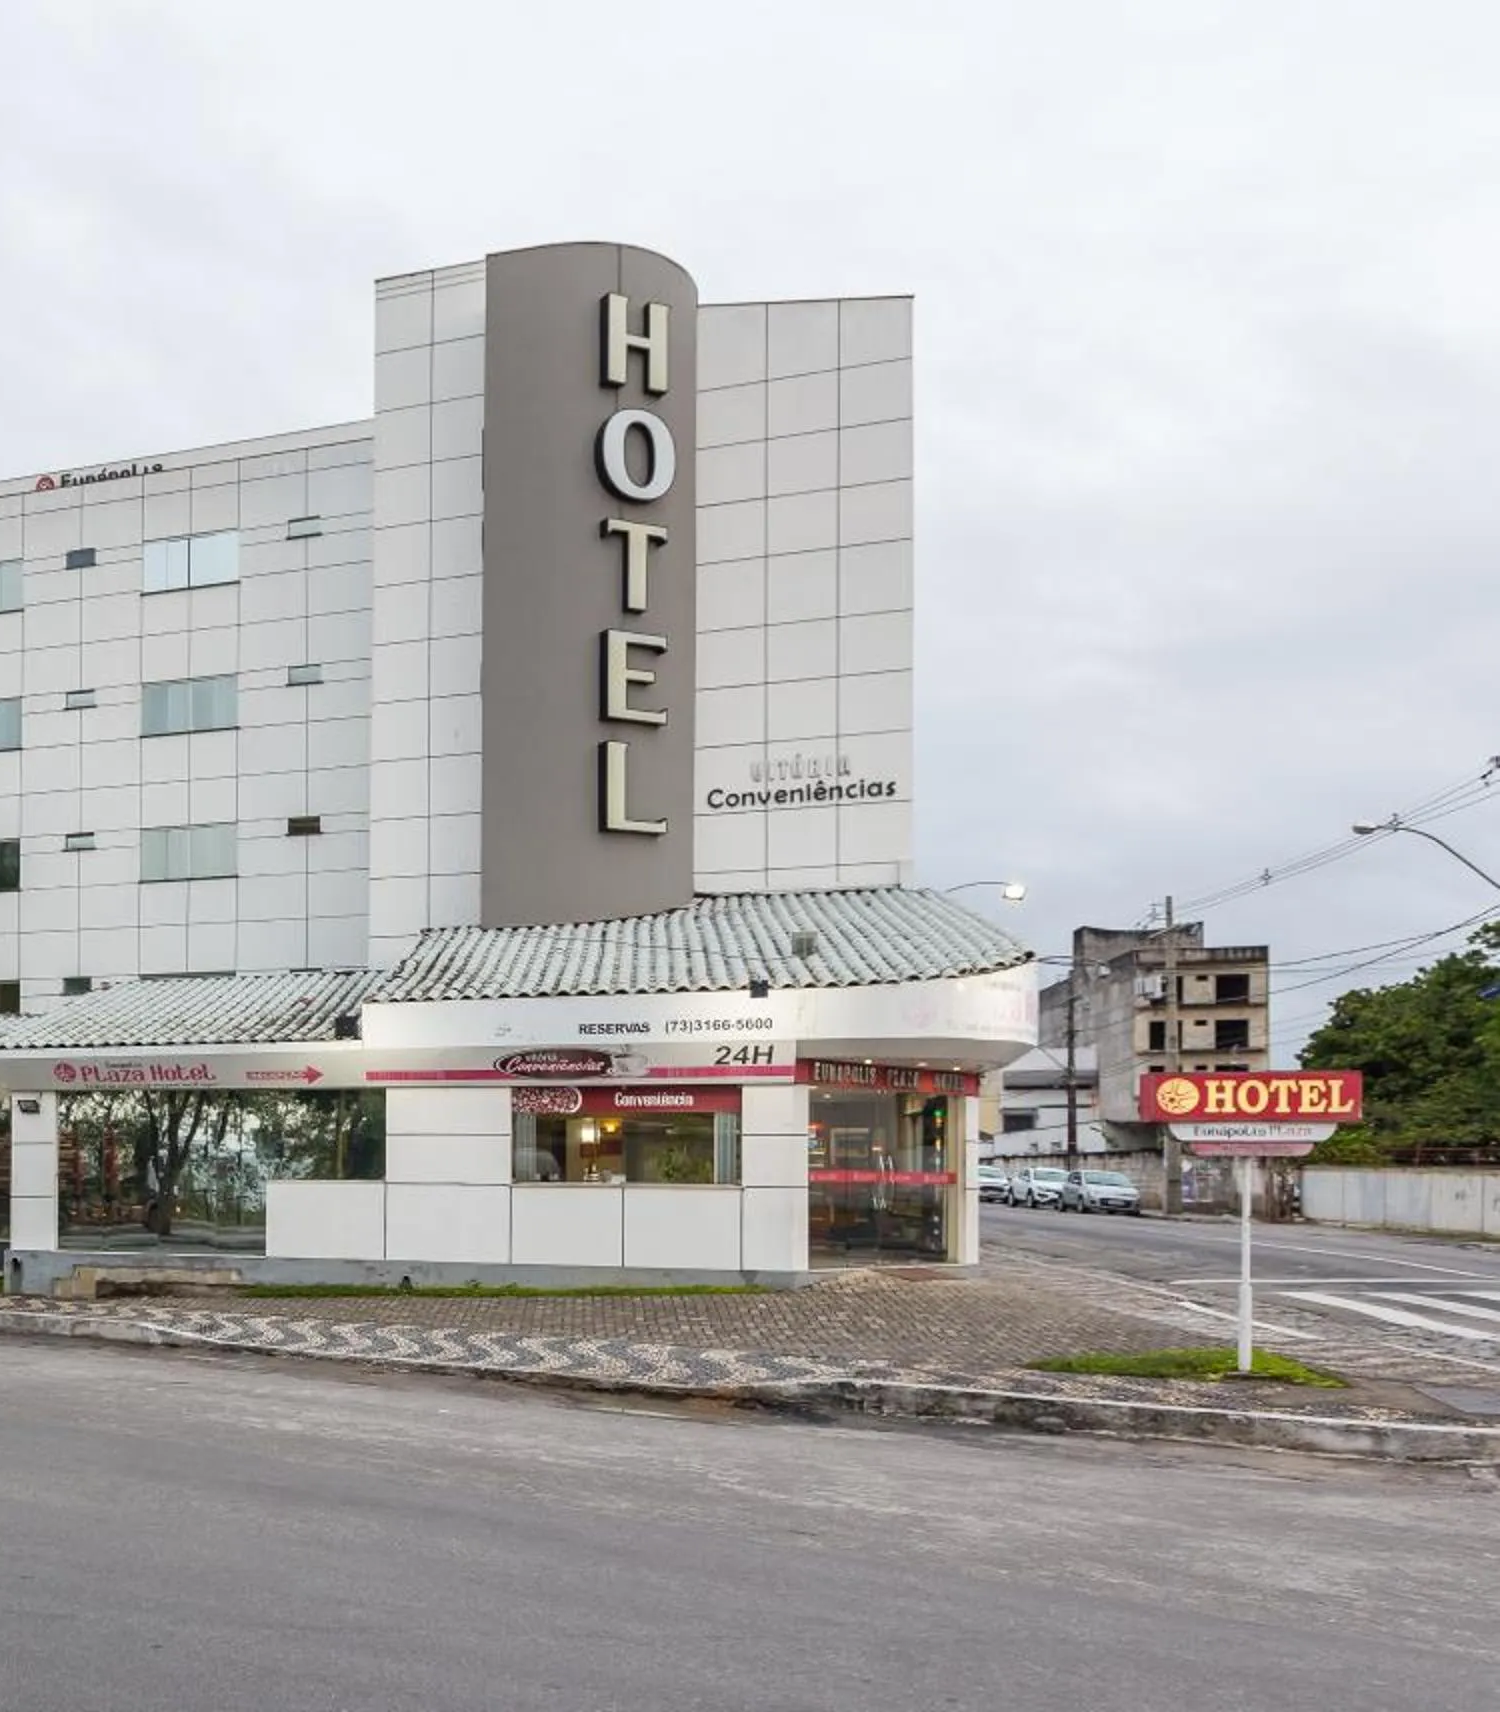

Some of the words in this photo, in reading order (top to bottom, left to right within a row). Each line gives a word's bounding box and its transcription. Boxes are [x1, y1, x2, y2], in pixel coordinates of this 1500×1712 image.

[594, 291, 676, 838] HOTEL
[707, 778, 897, 809] Conveniências
[579, 1022, 651, 1035] RESERVAS
[714, 1044, 775, 1066] 24H
[1203, 1079, 1354, 1114] HOTEL
